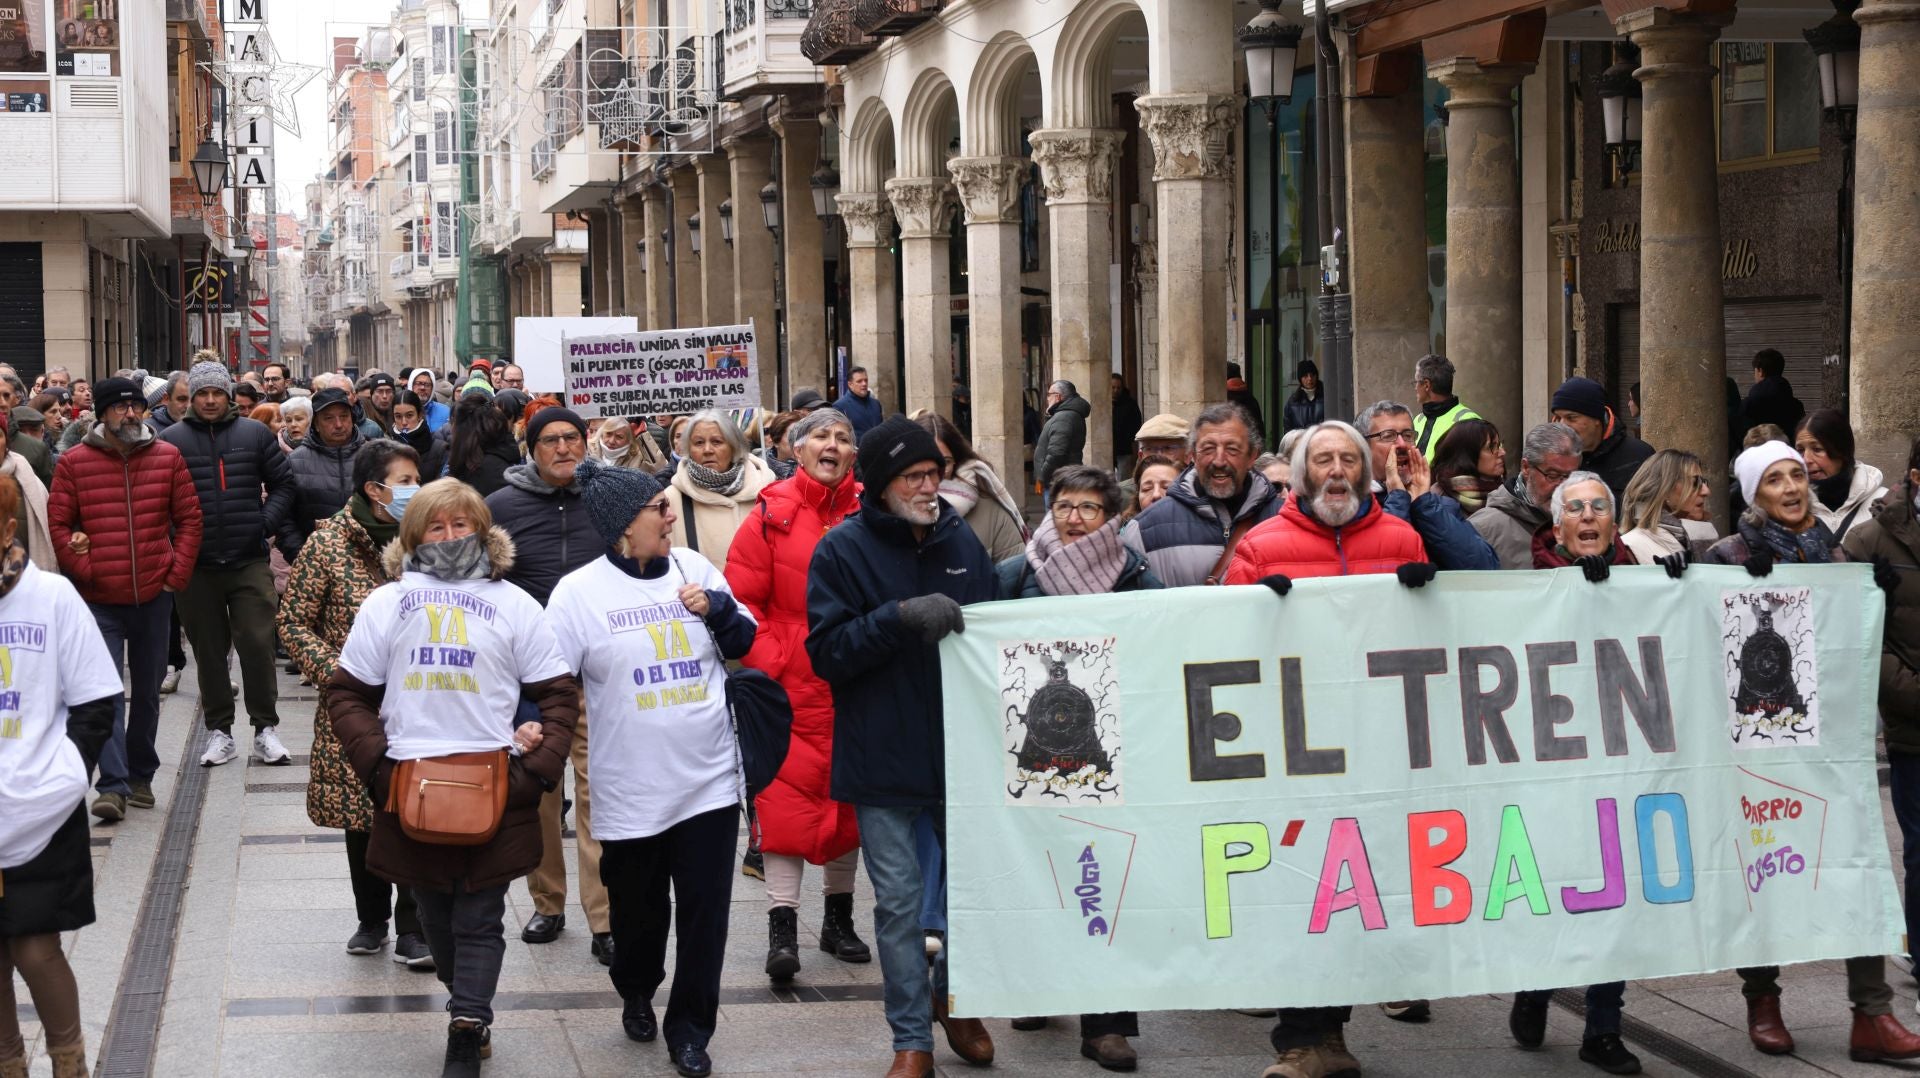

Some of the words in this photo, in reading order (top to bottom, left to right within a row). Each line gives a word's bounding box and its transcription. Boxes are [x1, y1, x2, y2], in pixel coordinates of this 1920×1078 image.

[1595, 222, 1640, 254] Pastele
[570, 339, 636, 356] PALENCIA
[639, 336, 681, 352] UNIDA
[684, 333, 705, 349] SIN
[706, 332, 753, 347] VALLAS
[571, 359, 585, 373] NI
[588, 358, 645, 372] PUENTES
[571, 375, 614, 389] JUNTA
[616, 374, 633, 387] DE
[572, 393, 591, 405] NO
[592, 392, 608, 404] SE
[609, 389, 650, 403] SUBEN
[651, 388, 668, 400] AL
[668, 386, 701, 400] TREN
[702, 385, 718, 397] DE
[721, 383, 745, 396] LAS
[599, 398, 714, 417] REIVINDICACIONES
[423, 603, 469, 646] YA
[644, 618, 693, 661] YA
[1023, 642, 1051, 656] TREN
[418, 646, 435, 665] EL
[439, 647, 477, 668] TREN
[633, 668, 645, 686] O
[648, 665, 666, 684] EL
[635, 690, 657, 712] NO
[1183, 656, 1347, 782] EL
[1366, 636, 1677, 770] TREN
[1740, 794, 1803, 826] BARRIO
